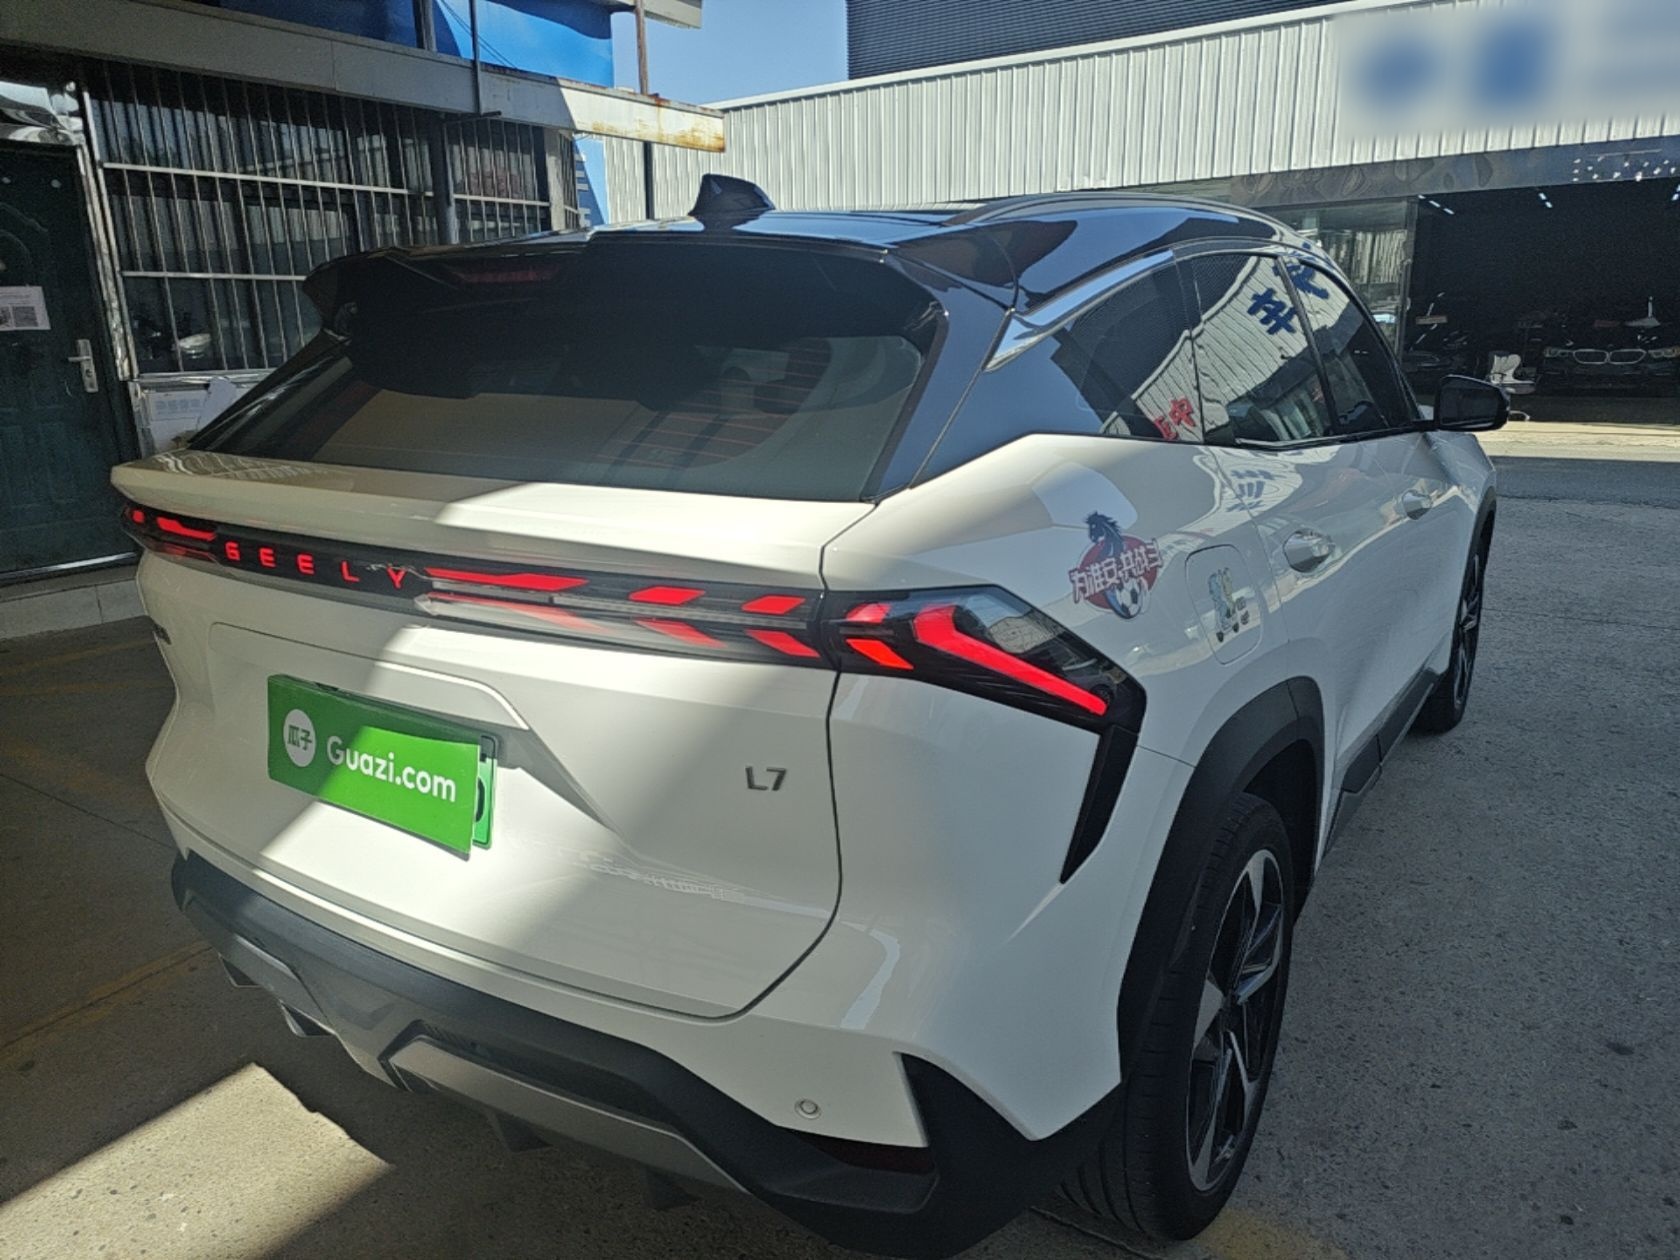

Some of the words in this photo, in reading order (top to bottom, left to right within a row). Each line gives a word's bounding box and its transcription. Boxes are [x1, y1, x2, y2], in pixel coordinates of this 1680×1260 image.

[225, 541, 406, 589] GEELY
[286, 724, 313, 751] 瓜子
[326, 735, 457, 803] Guazi.com
[745, 766, 787, 791] L7
